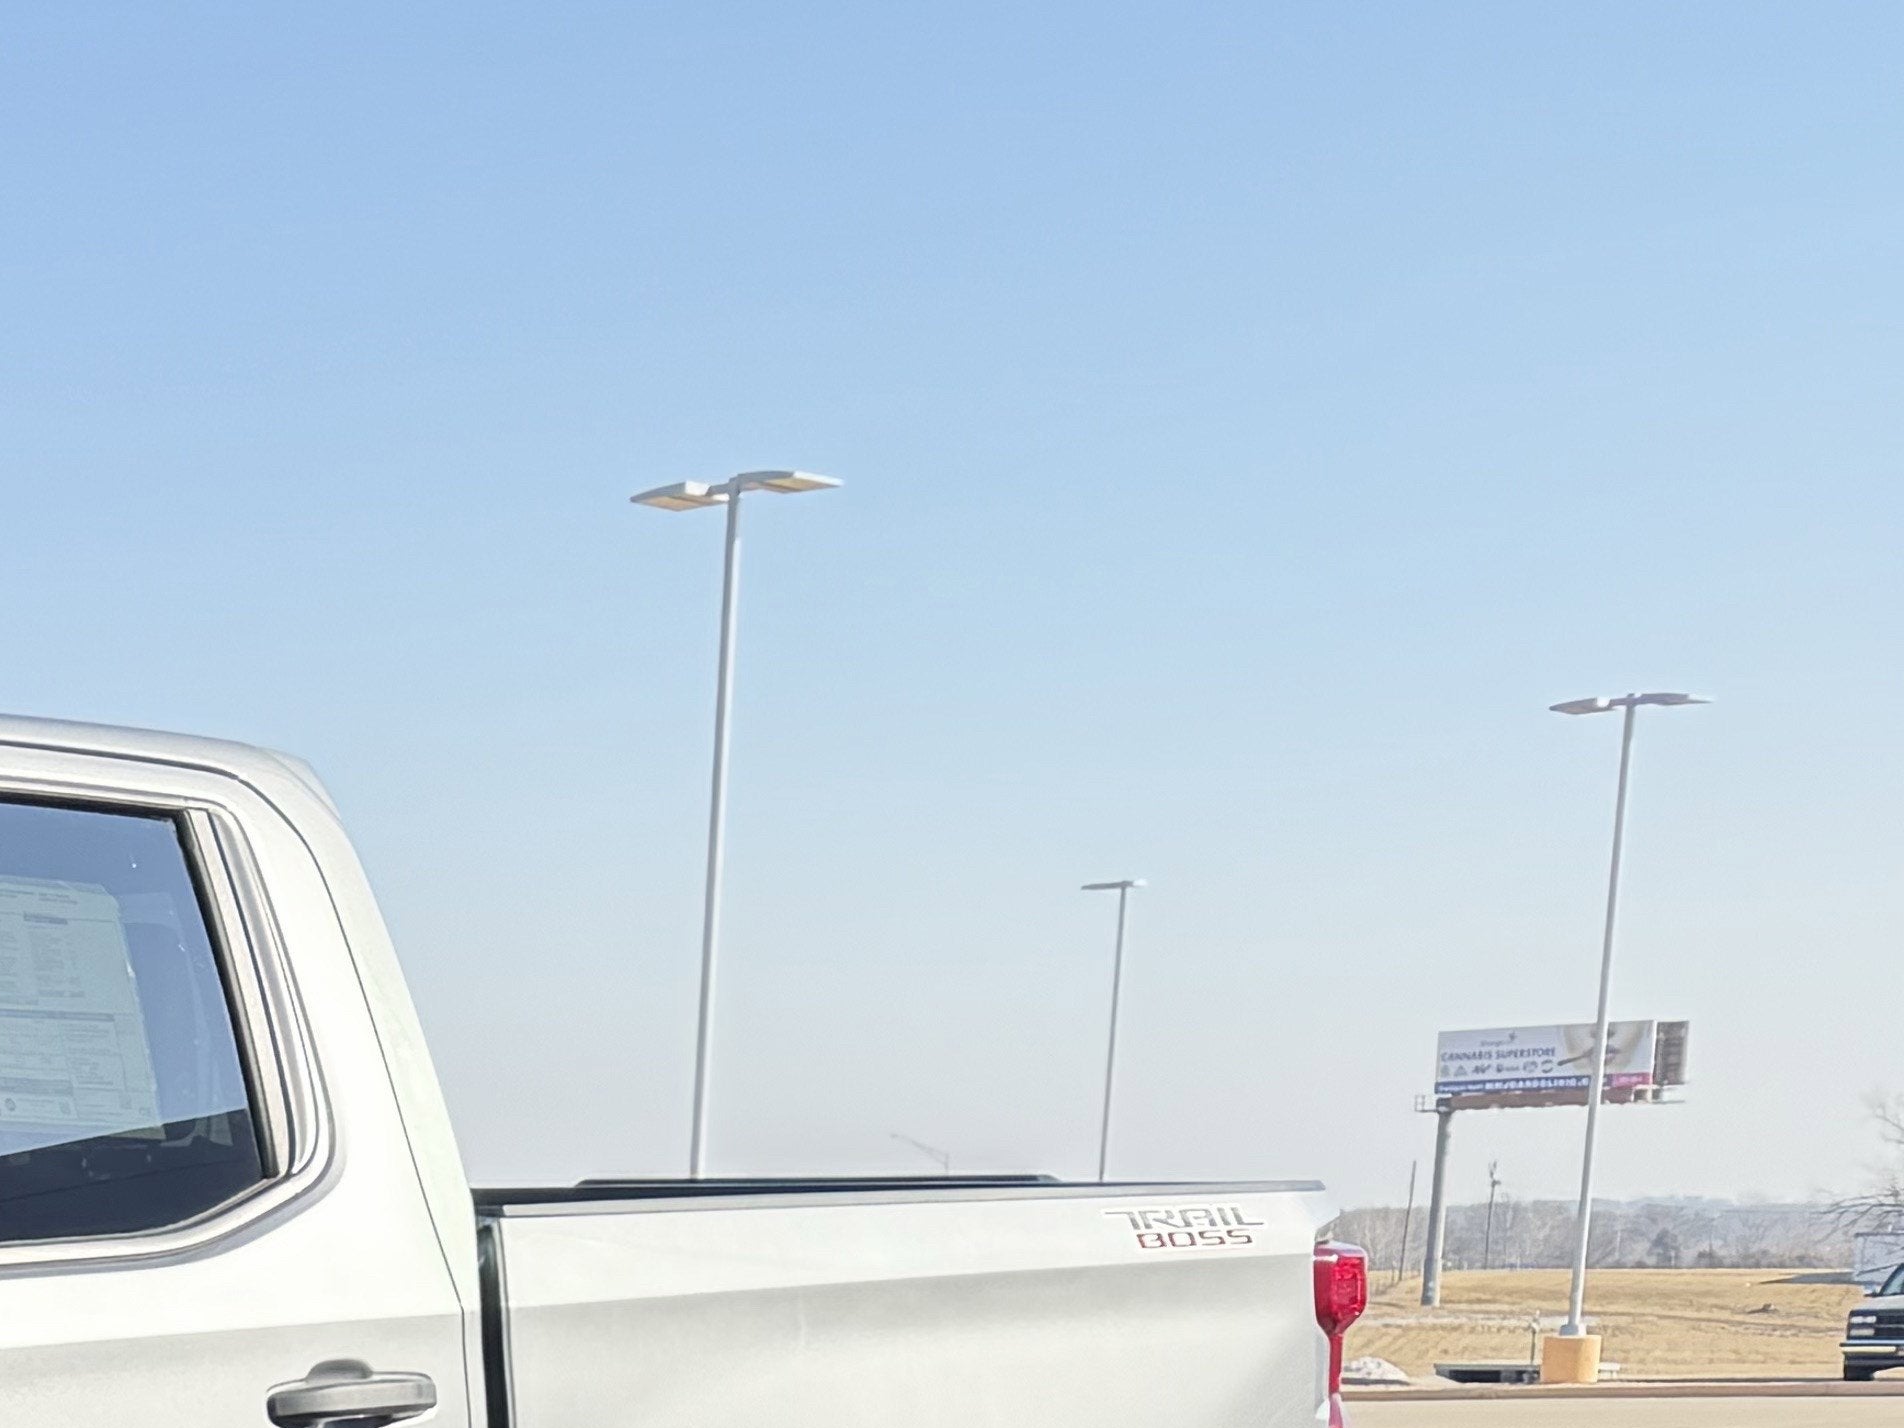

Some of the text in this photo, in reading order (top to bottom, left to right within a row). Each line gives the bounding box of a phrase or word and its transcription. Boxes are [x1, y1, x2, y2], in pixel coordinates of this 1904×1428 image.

[1442, 1046, 1556, 1062] CANNABIS SUPERSTORE
[1105, 1207, 1264, 1230] TRAIL
[1136, 1229, 1253, 1248] BOSS
